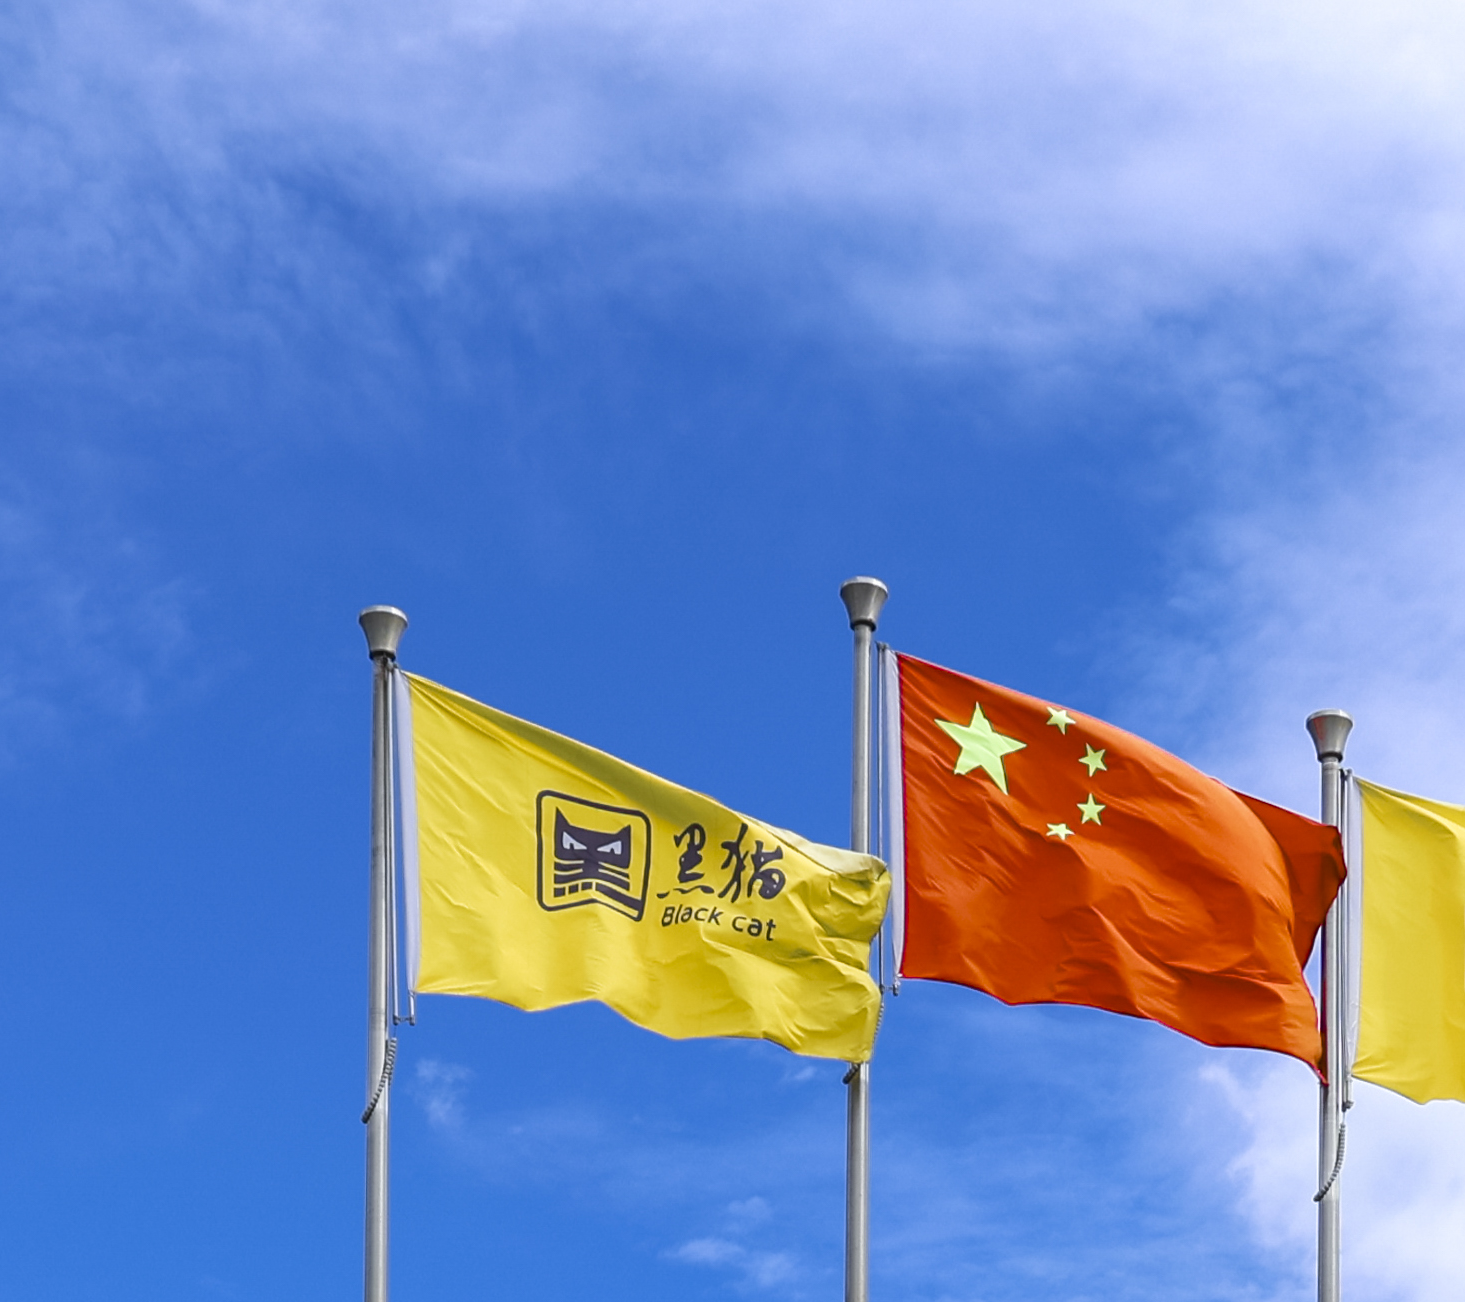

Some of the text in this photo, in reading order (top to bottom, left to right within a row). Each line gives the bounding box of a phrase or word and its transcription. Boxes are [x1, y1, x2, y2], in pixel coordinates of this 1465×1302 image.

[657, 822, 787, 904] 黑猫
[661, 903, 777, 942] Black cat
